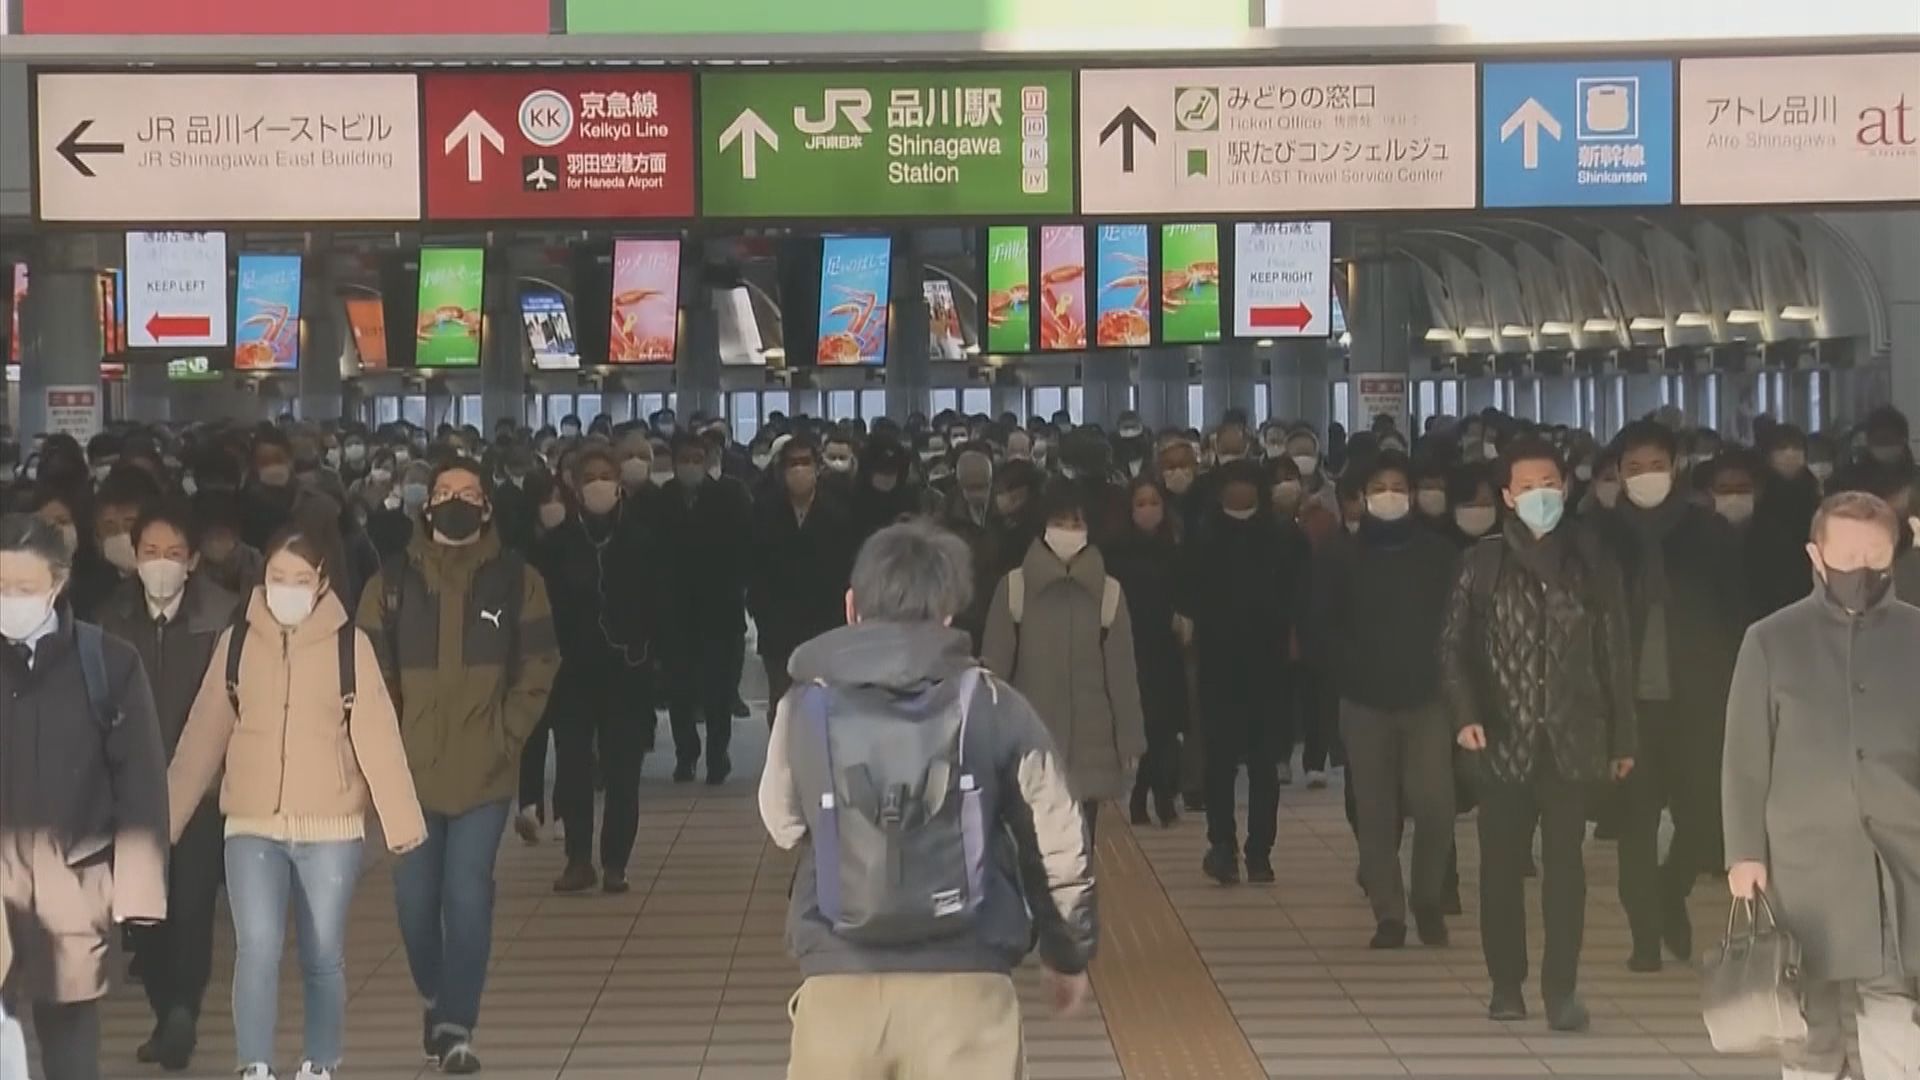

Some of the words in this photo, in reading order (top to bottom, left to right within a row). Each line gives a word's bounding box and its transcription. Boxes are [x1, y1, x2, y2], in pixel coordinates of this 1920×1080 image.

[580, 91, 658, 118] 京急線
[888, 87, 1002, 128] 品川駅
[1227, 84, 1376, 110] みどりの窓口
[530, 107, 562, 127] KK
[794, 88, 872, 133] JR
[1706, 95, 1838, 126] アトレ品川
[137, 116, 175, 144] JR
[187, 114, 393, 144] 品川イーストビル
[636, 121, 668, 138] Line
[1277, 115, 1322, 129] Office
[888, 134, 1001, 159] Shinagawa
[1227, 137, 1449, 165] 駅たびコンシェルジュ
[1747, 131, 1837, 152] Shinagawa
[138, 152, 163, 168] JR
[169, 151, 269, 171] Shinagawa
[276, 151, 315, 167] East
[322, 149, 393, 169] Building
[567, 154, 667, 174] 羽田空港方面
[1578, 145, 1646, 168] 新幹線
[567, 176, 582, 188] for
[584, 176, 625, 188] Haneda
[628, 175, 663, 191] Airport
[888, 162, 959, 184] Station
[1296, 168, 1337, 184] Travel
[1341, 167, 1394, 183] Service
[1397, 167, 1445, 183] Center
[1578, 169, 1648, 184] Shinkansen
[147, 281, 177, 292] KEEP
[179, 280, 206, 292] LEFT
[1250, 272, 1279, 283] KEEP
[1282, 272, 1313, 283] RIGHT
